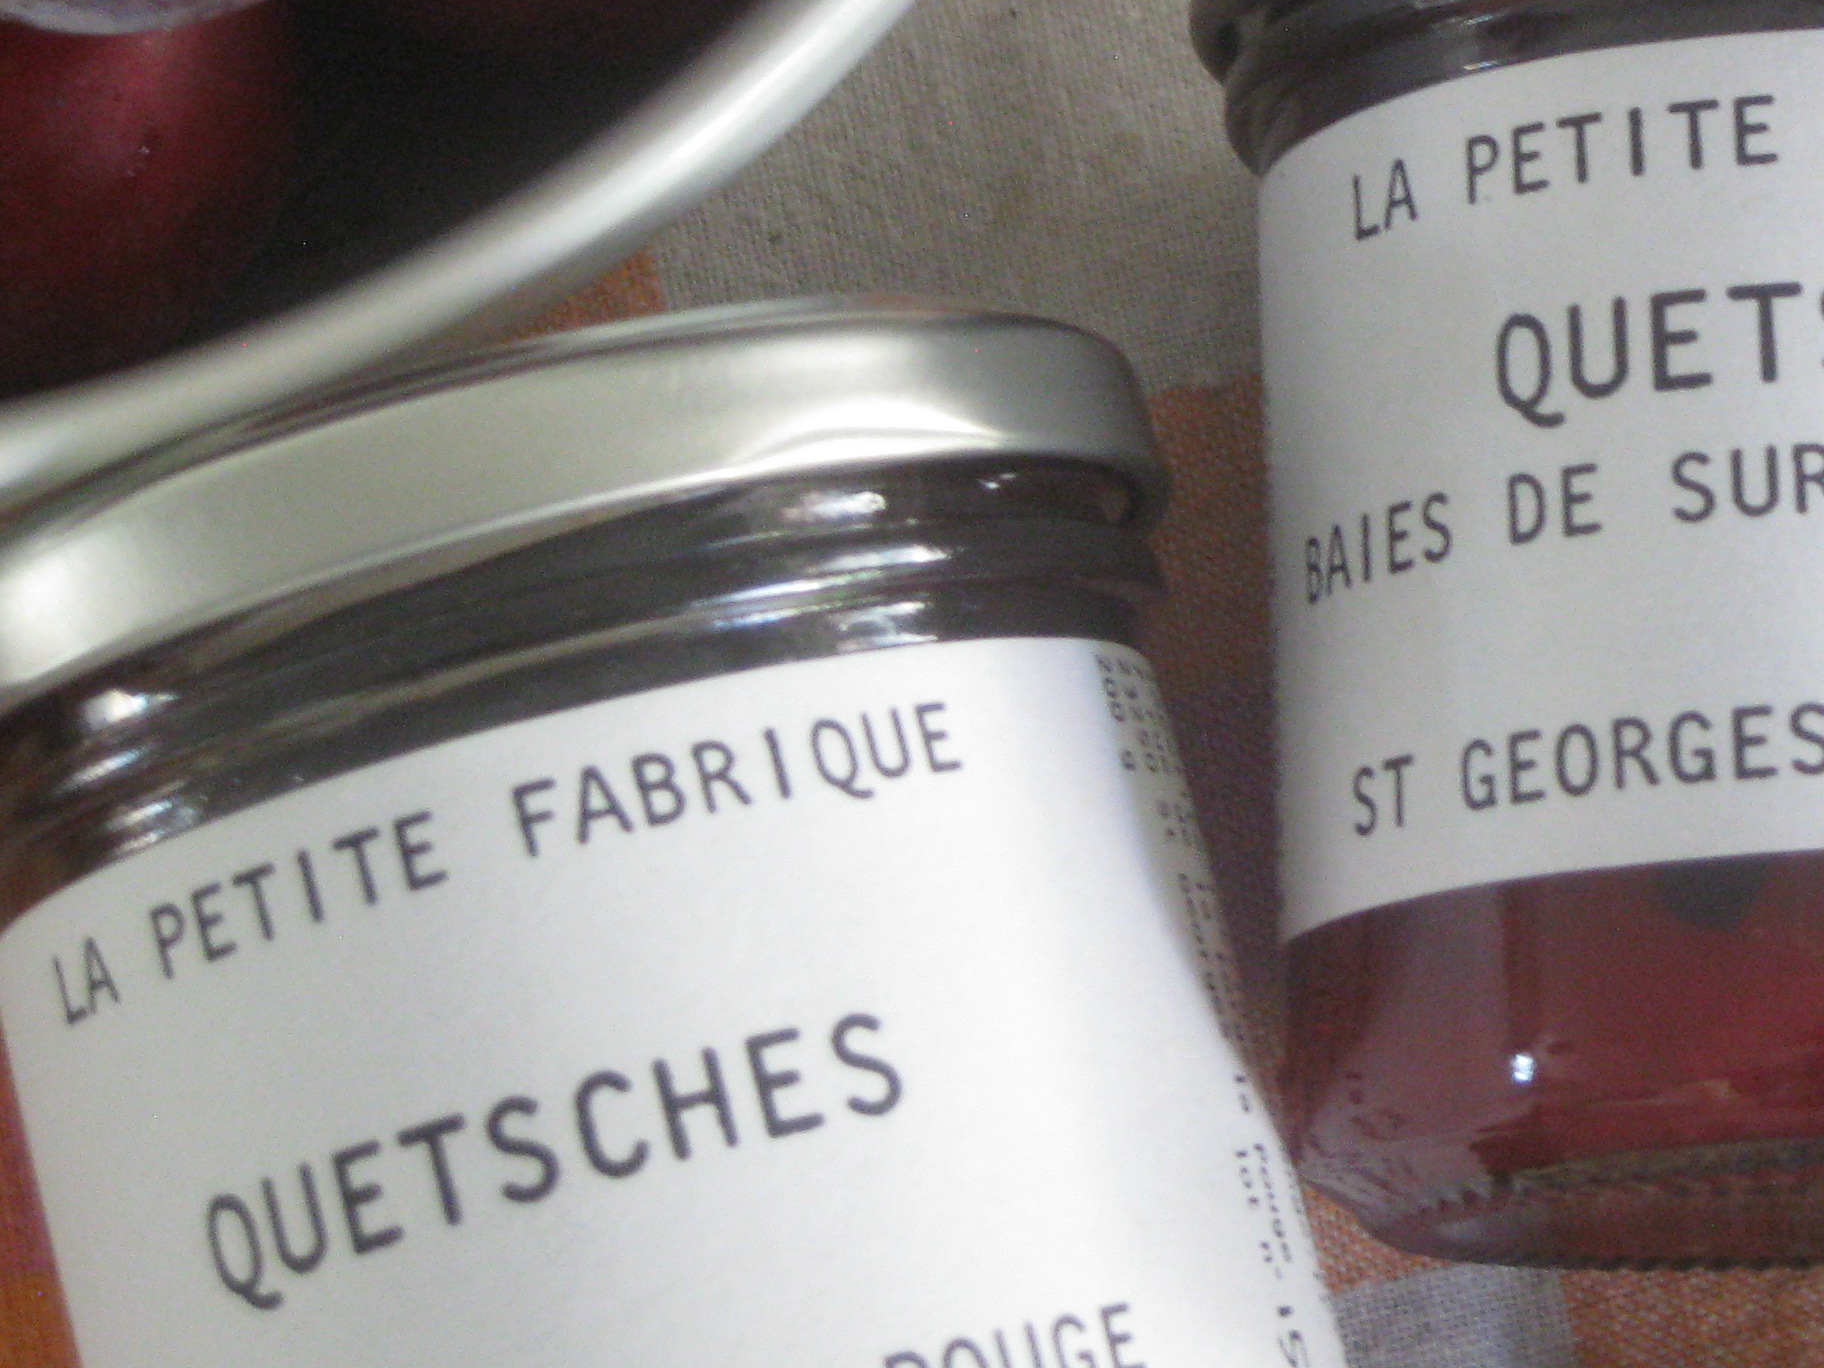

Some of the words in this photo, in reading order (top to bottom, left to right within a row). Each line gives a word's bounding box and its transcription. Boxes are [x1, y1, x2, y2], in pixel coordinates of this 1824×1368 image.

[1352, 158, 1418, 241] LA
[1466, 94, 1779, 205] PETITE
[1305, 492, 1452, 607] BAIES
[1507, 463, 1602, 545] DE
[54, 938, 119, 1026] LA
[149, 811, 447, 979] PETITE
[511, 702, 961, 857] FABRIQUE
[1353, 754, 1414, 837] ST
[206, 1013, 902, 1311] QUETSCHES
